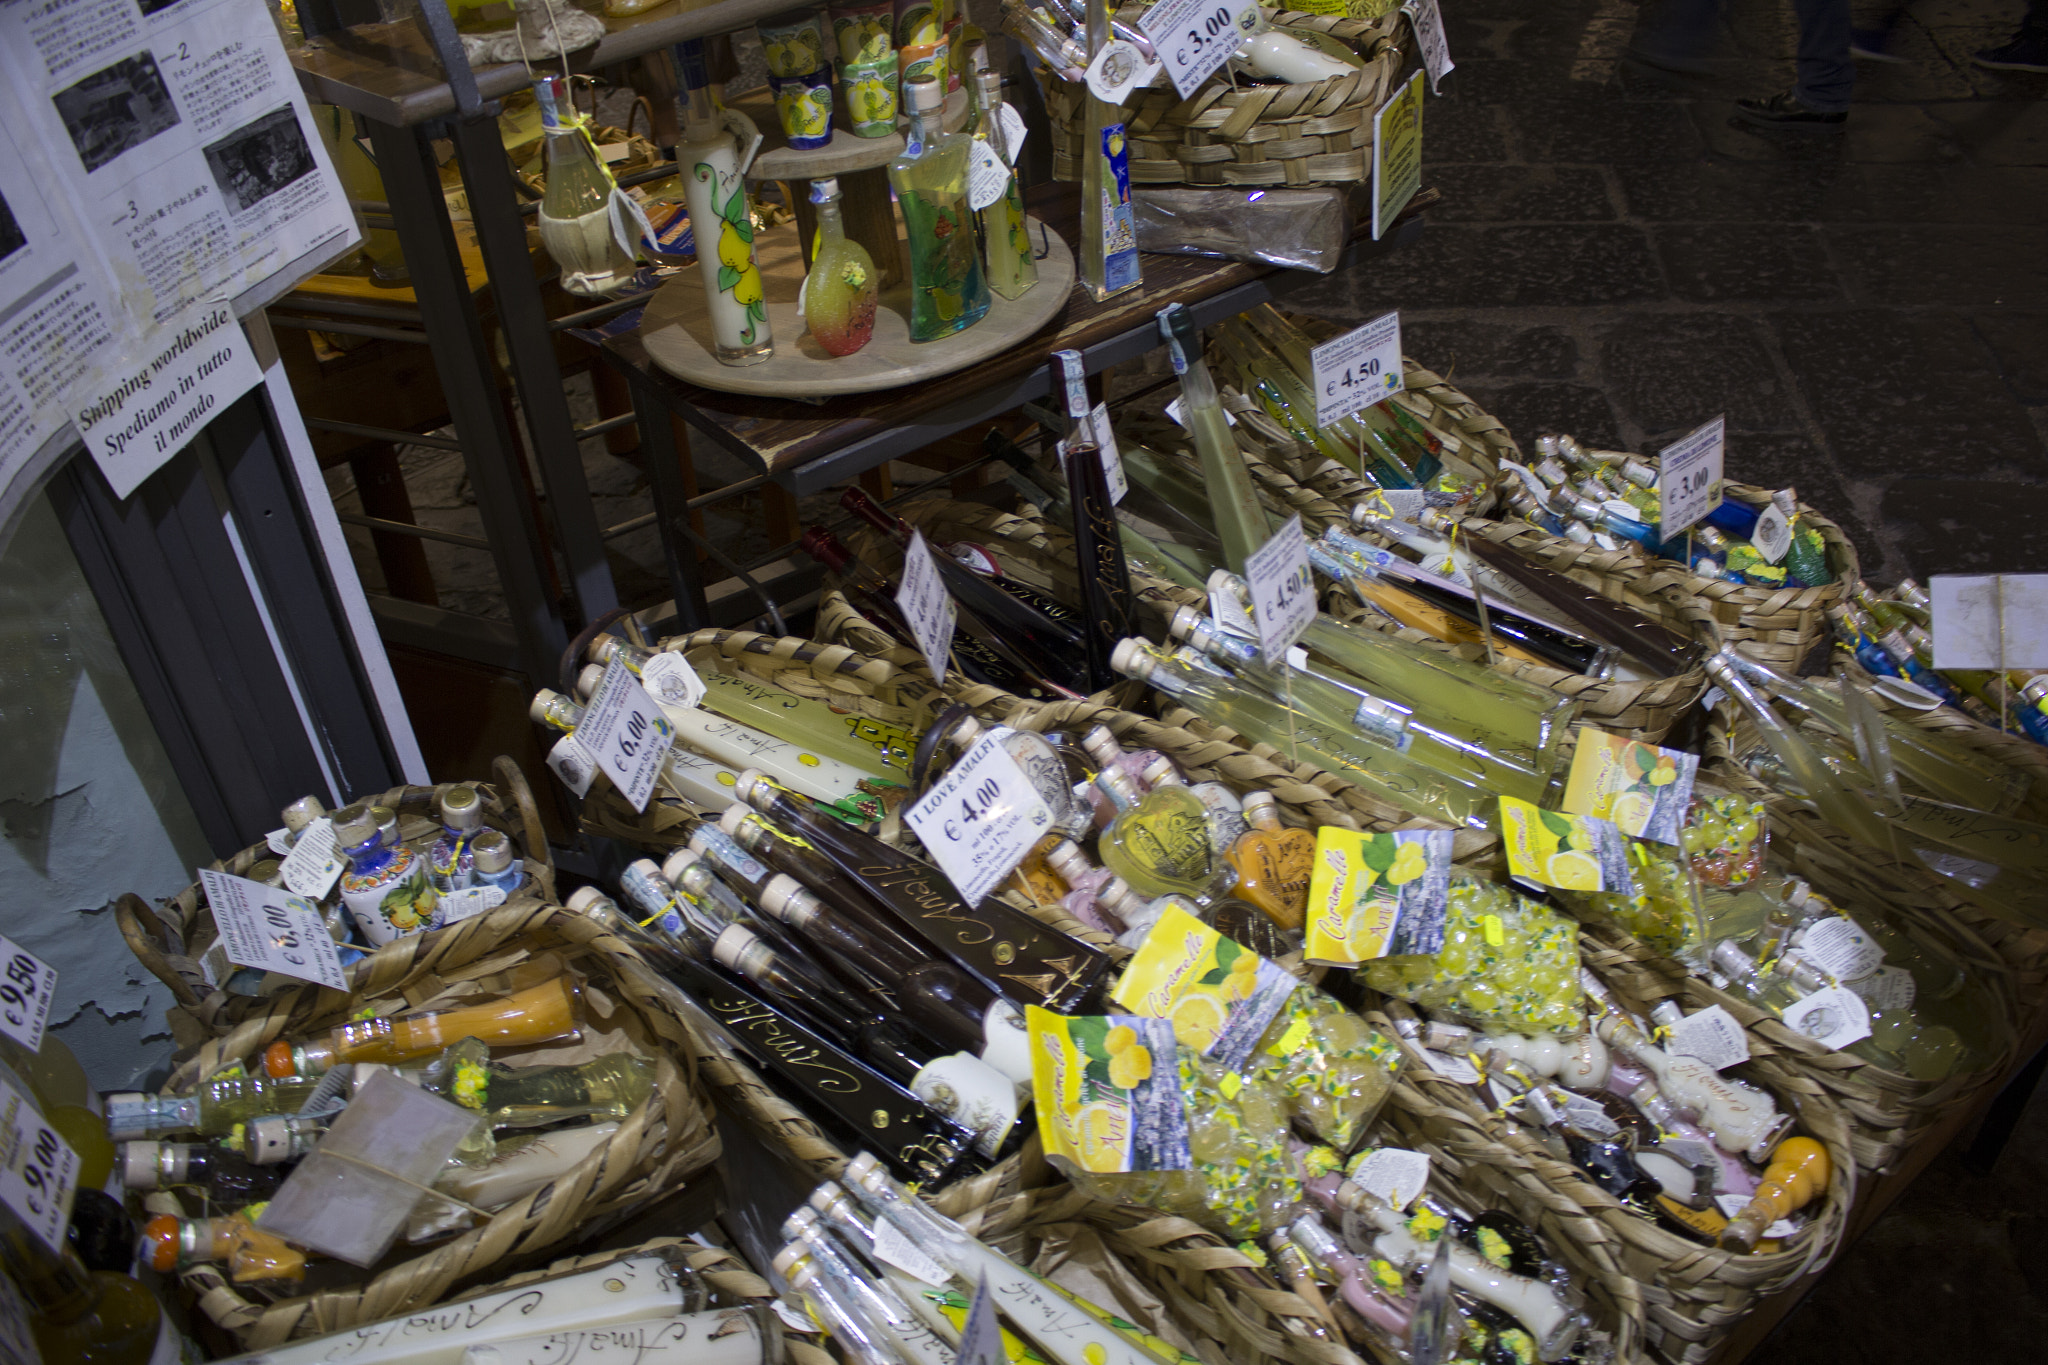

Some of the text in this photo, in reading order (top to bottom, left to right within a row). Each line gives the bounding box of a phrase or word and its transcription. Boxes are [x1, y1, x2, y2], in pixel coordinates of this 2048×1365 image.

[179, 42, 190, 61] 2
[1177, 48, 1187, 66] €
[1188, 8, 1230, 53] 3,00
[127, 200, 139, 219] 3
[79, 368, 152, 431] Shipping
[150, 309, 228, 374] worldwide
[1326, 358, 1380, 396] € 4,50
[104, 347, 232, 457] Spediamo in tutto
[153, 392, 215, 452] il mondo
[1669, 488, 1677, 505] €
[1263, 600, 1276, 622] €
[614, 711, 647, 773] € 6,00
[913, 739, 994, 824] I LOVE AMALFI
[944, 778, 999, 841] € 4.00
[972, 825, 993, 849] ml 100
[972, 852, 989, 867] 35%
[992, 831, 1009, 845] 17%
[1006, 815, 1022, 828] VOL.
[1317, 850, 1348, 941] Caramelle
[1369, 884, 1399, 941] Amalfi
[219, 910, 243, 960] LIMONCELLO
[263, 905, 305, 965] € 6,00
[0, 955, 36, 1026] € 9,50
[1148, 931, 1204, 1020] Caramelle
[709, 998, 862, 1093] Amalfi
[1042, 1033, 1079, 1147] Caramelle
[1089, 1079, 1139, 1158] Amalfi
[24, 1129, 57, 1216] € 9,00
